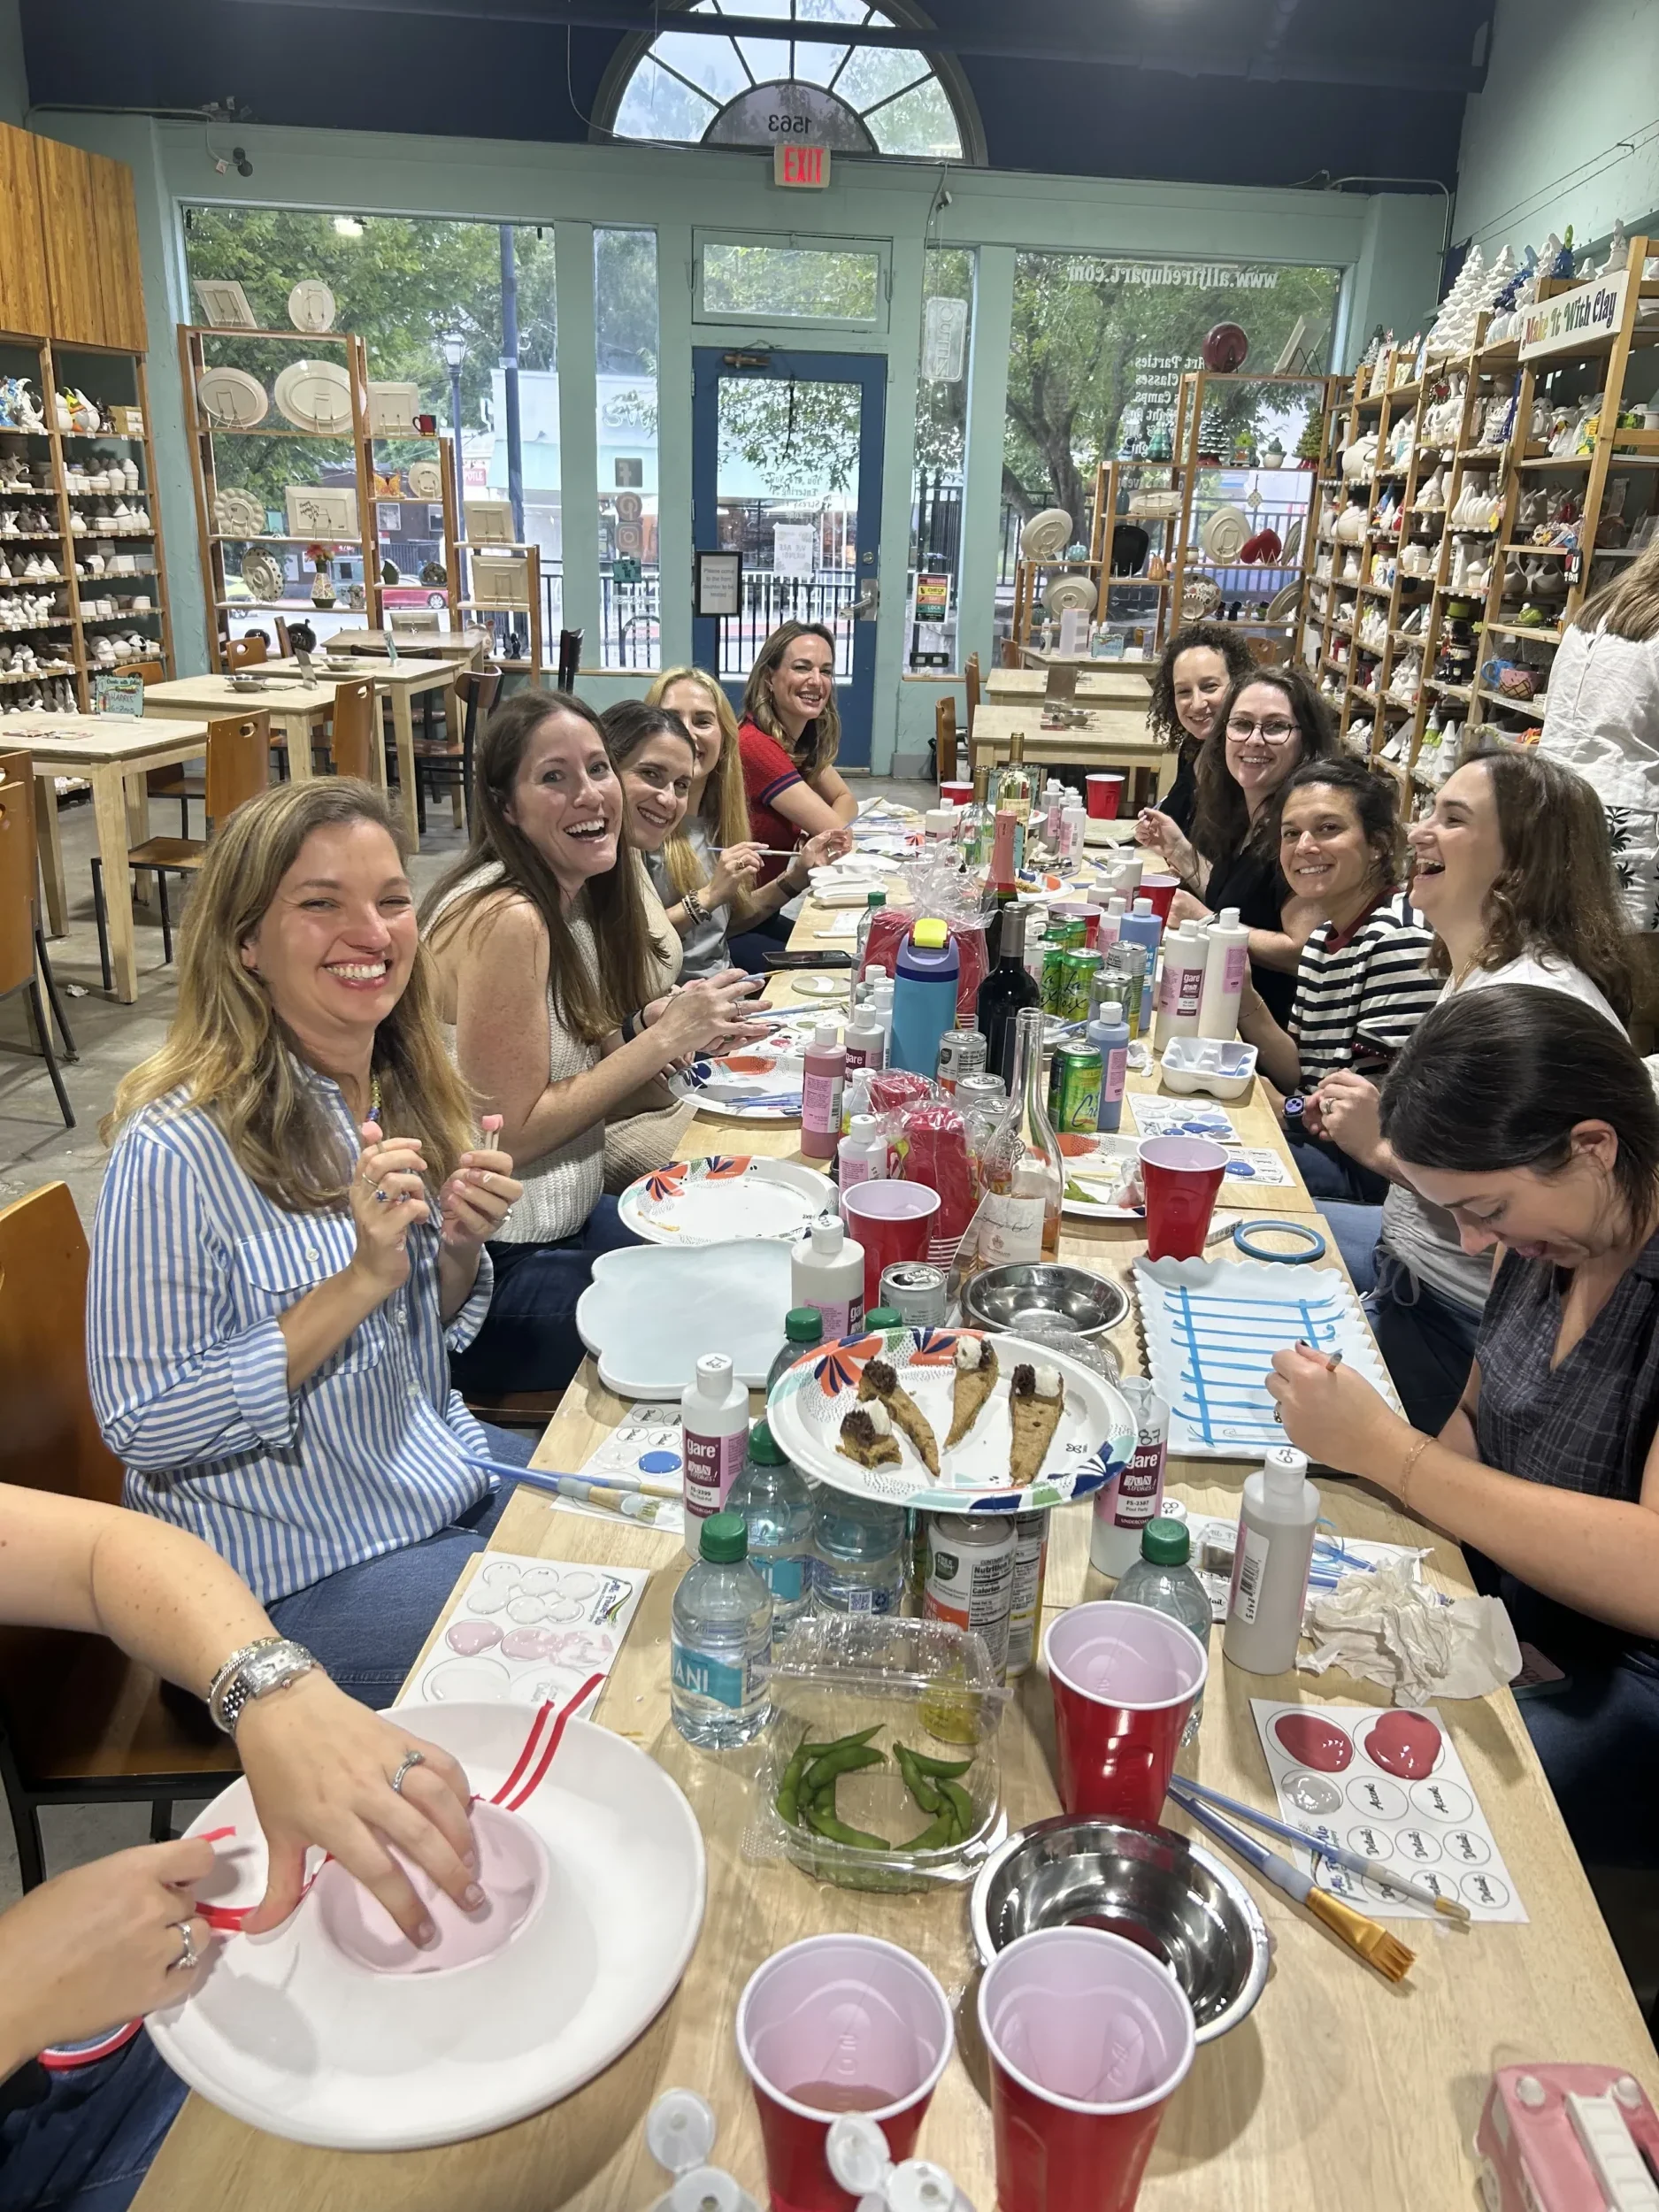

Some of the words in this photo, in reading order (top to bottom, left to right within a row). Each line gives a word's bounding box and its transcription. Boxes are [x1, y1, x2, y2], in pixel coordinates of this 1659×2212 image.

[784, 146, 825, 183] EXIT
[1522, 311, 1549, 350] Make
[1550, 308, 1562, 337] It
[1564, 296, 1591, 332] With
[1593, 288, 1617, 329] Clay
[1184, 974, 1201, 983] gare
[687, 1438, 716, 1458] gare
[1139, 1429, 1160, 1445] 87
[974, 1563, 1007, 1574] Nutrition
[972, 1585, 1001, 1594] Calories
[1363, 1783, 1384, 1811] Accent
[1427, 1786, 1449, 1814] Accent
[1360, 1828, 1380, 1855] Detail
[1408, 1831, 1428, 1858] Detail
[1456, 1832, 1477, 1860] Detail
[1474, 1874, 1495, 1904] Detail
